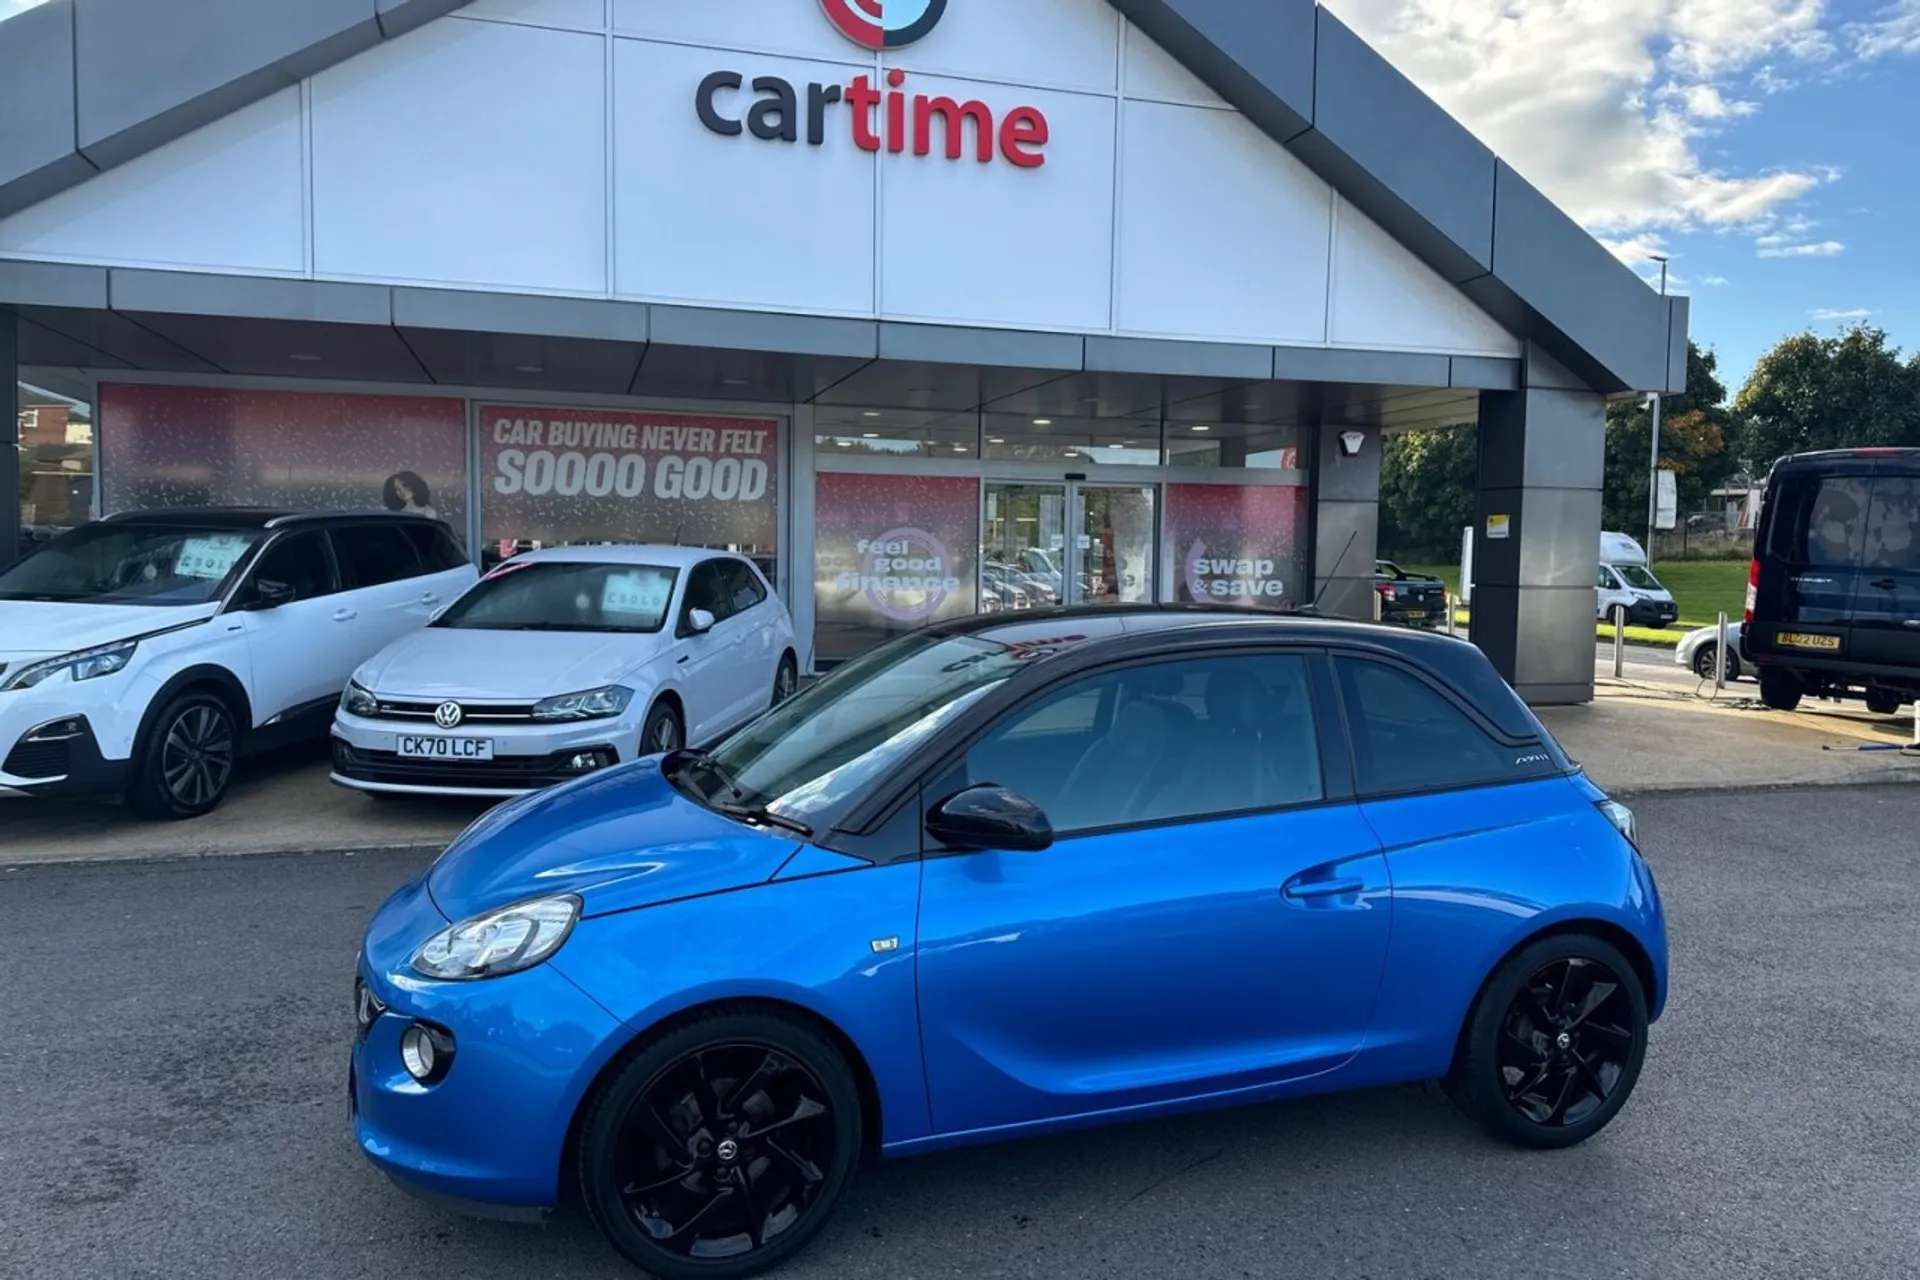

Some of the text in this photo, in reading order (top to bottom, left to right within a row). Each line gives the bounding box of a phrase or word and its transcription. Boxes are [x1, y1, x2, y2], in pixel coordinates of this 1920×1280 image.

[695, 68, 1048, 168] cartime
[494, 419, 768, 454] CAR BUYING NEVER FELT
[494, 449, 768, 500] SOOOO GOOD
[857, 539, 909, 555] feel
[875, 557, 942, 573] good
[1192, 558, 1274, 578] swap
[836, 572, 960, 592] finance
[1192, 578, 1284, 596] & save
[403, 738, 487, 756] CK70 LCF
